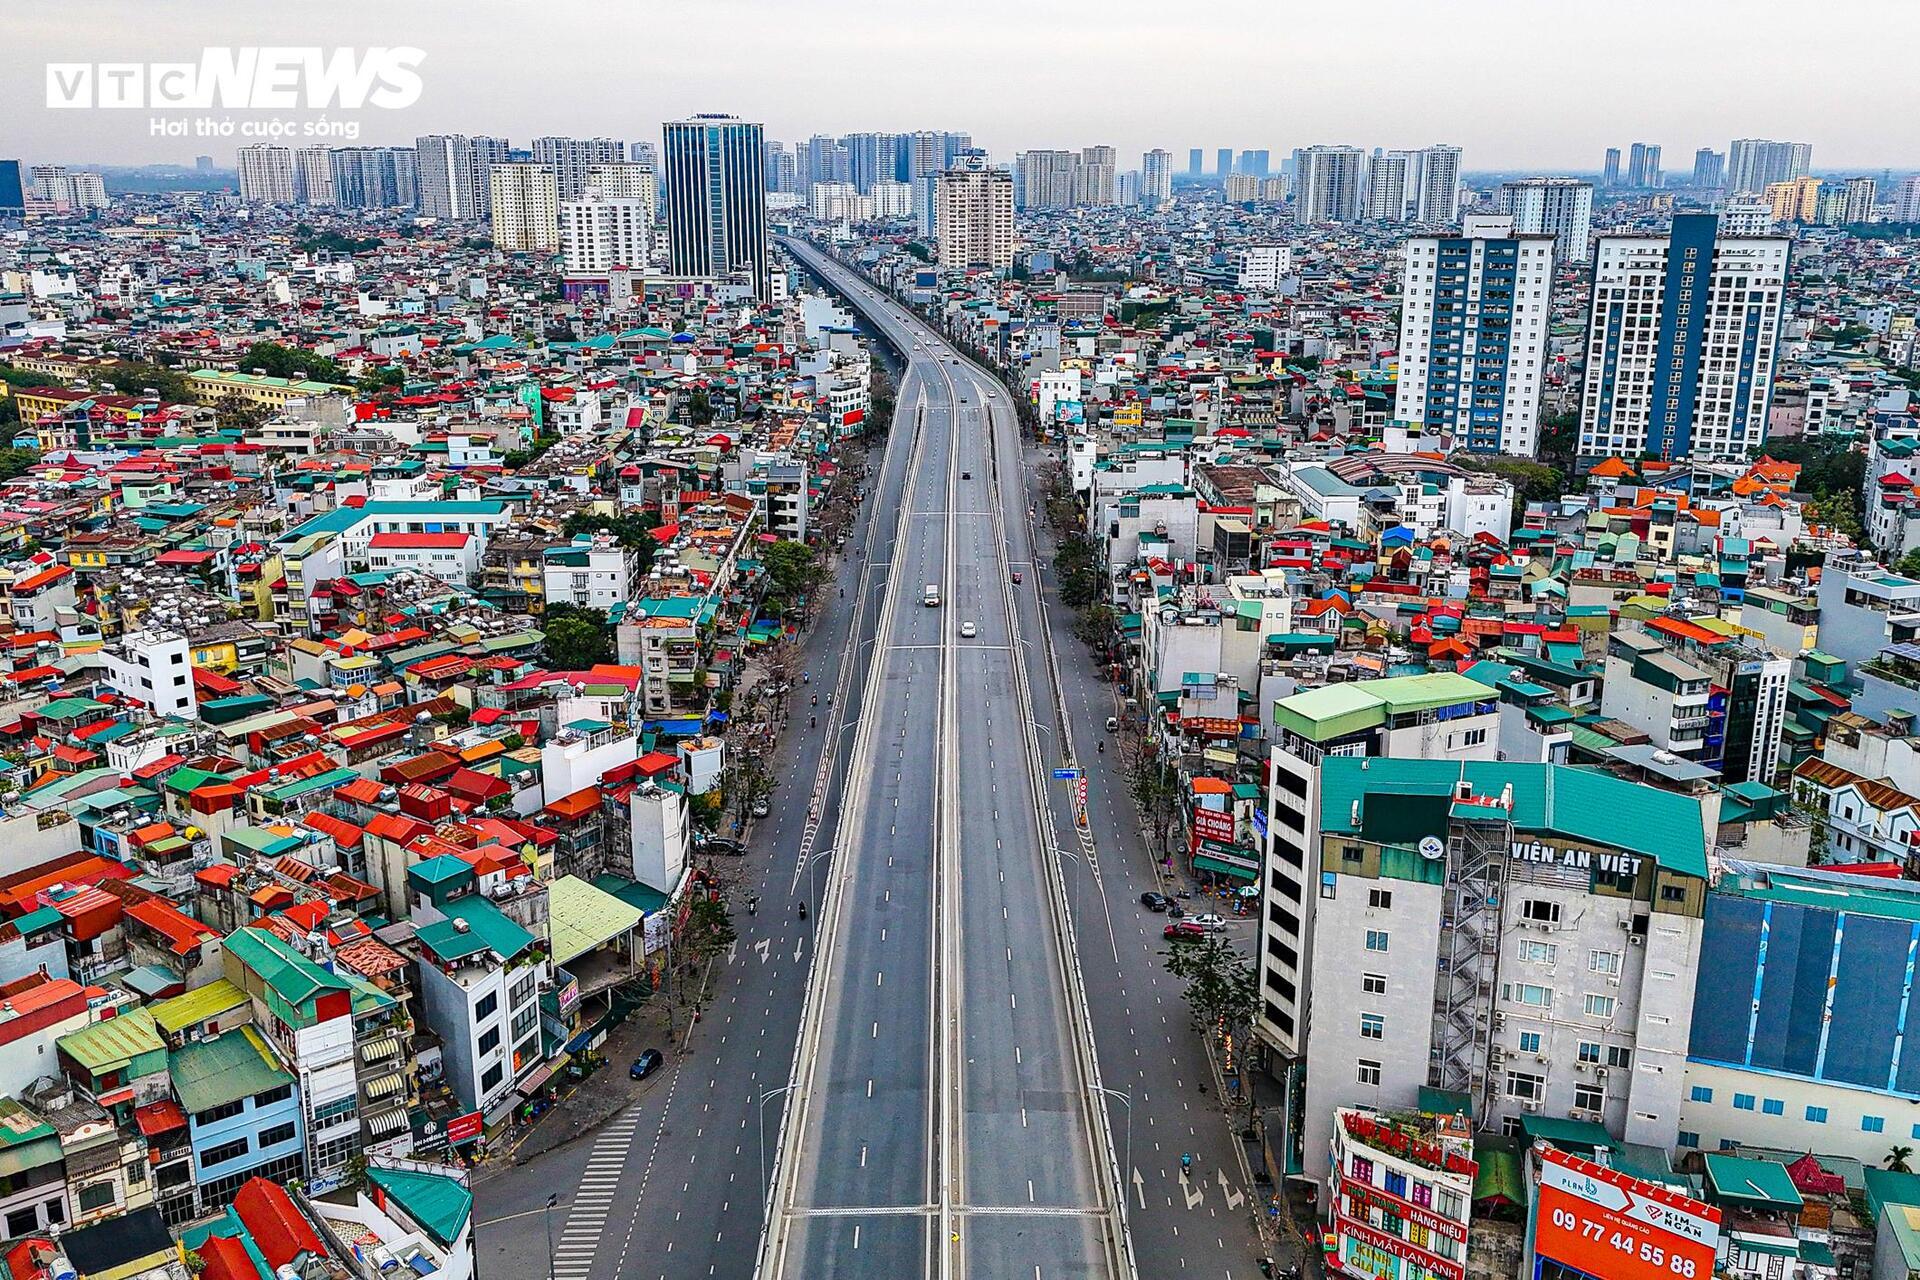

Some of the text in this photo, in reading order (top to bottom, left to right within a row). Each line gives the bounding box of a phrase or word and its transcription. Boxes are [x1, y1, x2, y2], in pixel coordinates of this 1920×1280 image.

[1196, 815, 1231, 831] GIÁ CHOÁNG
[1511, 841, 1642, 876] VIỆN AN VIỆT
[1562, 1178, 1584, 1192] PLAN
[1410, 1209, 1438, 1230] HÀNG
[1440, 1222, 1462, 1239] HIỆU
[1603, 1212, 1650, 1235] LIÊN HỆ QUẢNG CÁO
[1664, 1210, 1690, 1224] KIM
[1664, 1218, 1702, 1238] NGAN
[1343, 1224, 1370, 1243] KÍNH
[1373, 1237, 1400, 1255] MẮT
[1402, 1249, 1427, 1267] LAN
[1429, 1261, 1458, 1279] ANH
[1552, 1208, 1696, 1279] 09 77 44 55 88
